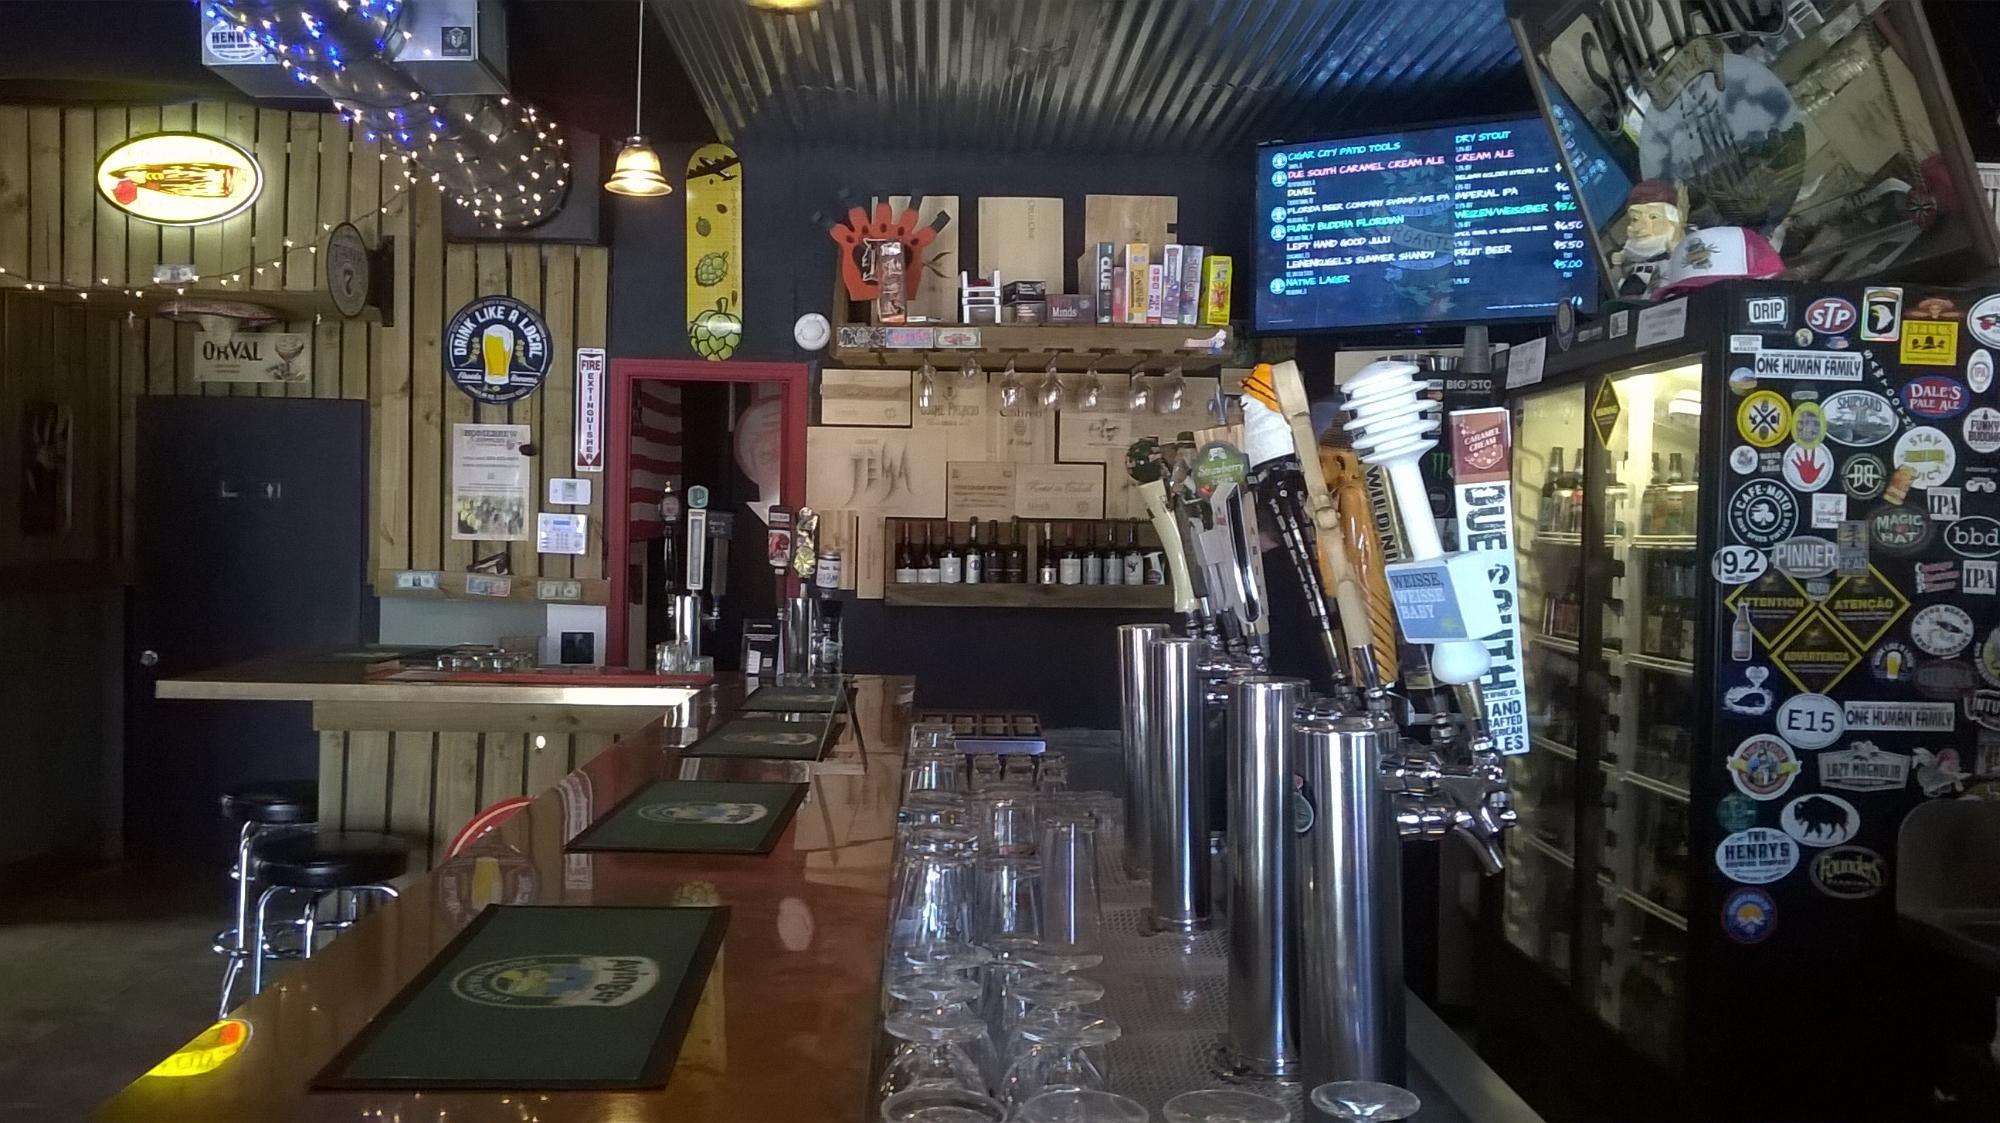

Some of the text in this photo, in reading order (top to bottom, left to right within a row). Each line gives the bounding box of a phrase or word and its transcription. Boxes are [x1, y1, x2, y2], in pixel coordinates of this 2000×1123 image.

[1455, 131, 1511, 144] DRY STOUT
[1317, 150, 1337, 159] CITY
[1339, 145, 1366, 155] PATIO
[1369, 142, 1401, 151] TOOLS
[1455, 149, 1515, 163] CREAM ALE
[1287, 155, 1445, 179] DUE SOUTH CARAMEL CREAM ALE
[1287, 187, 1316, 197] DUVEL
[1455, 187, 1518, 200] IMPERIAL IPA
[1287, 205, 1321, 215] FLORIDA
[1322, 203, 1344, 212] BEER
[1345, 199, 1384, 209] COMPANY
[1286, 223, 1315, 233] FUNKY
[1317, 219, 1354, 230] BUDDHA
[1286, 242, 1311, 251] LEFT
[1313, 238, 1338, 249] HAND
[1340, 237, 1366, 247] GOOD
[1454, 244, 1512, 257] FRUIT BEER
[1355, 253, 1395, 264] SUMMER
[1398, 250, 1436, 261] SHANDY
[1100, 256, 1113, 291] CLUE
[1285, 274, 1351, 287] NATIVE LAGER
[1753, 302, 1783, 321] DRIP
[1811, 303, 1851, 329] STP
[454, 306, 543, 359] DRINK LIKE A LOCAL
[581, 359, 601, 371] FIRE
[1756, 358, 1861, 376] ONE HUMAN FAMILY
[1911, 384, 1961, 400] DALE'S
[1910, 399, 1960, 411] PALE ALE
[586, 372, 594, 461] EXTINGUISHER
[1971, 420, 2000, 432] FUNKY
[1464, 427, 1501, 446] CARAMEL
[1469, 436, 1497, 453] CREAM
[1909, 433, 1943, 447] STAY
[1366, 465, 1391, 530] WILD
[1929, 495, 1960, 516] IPA
[1464, 485, 1508, 552] DUE
[1876, 515, 1923, 530] MAGIC
[1880, 531, 1919, 544] HAT
[1953, 526, 2000, 546] bbd
[1722, 549, 1760, 574] 9.2
[1775, 543, 1837, 568] PINNER
[1390, 572, 1445, 590] WEISSE,
[1964, 568, 1995, 589] IPA
[1394, 588, 1446, 604] WEISSE
[1399, 604, 1436, 620] BABY
[1491, 700, 1521, 717] AND
[1787, 708, 1836, 733] E15
[1845, 710, 1953, 727] ONE HUMAN FAMILY
[1746, 831, 1767, 841] TWO
